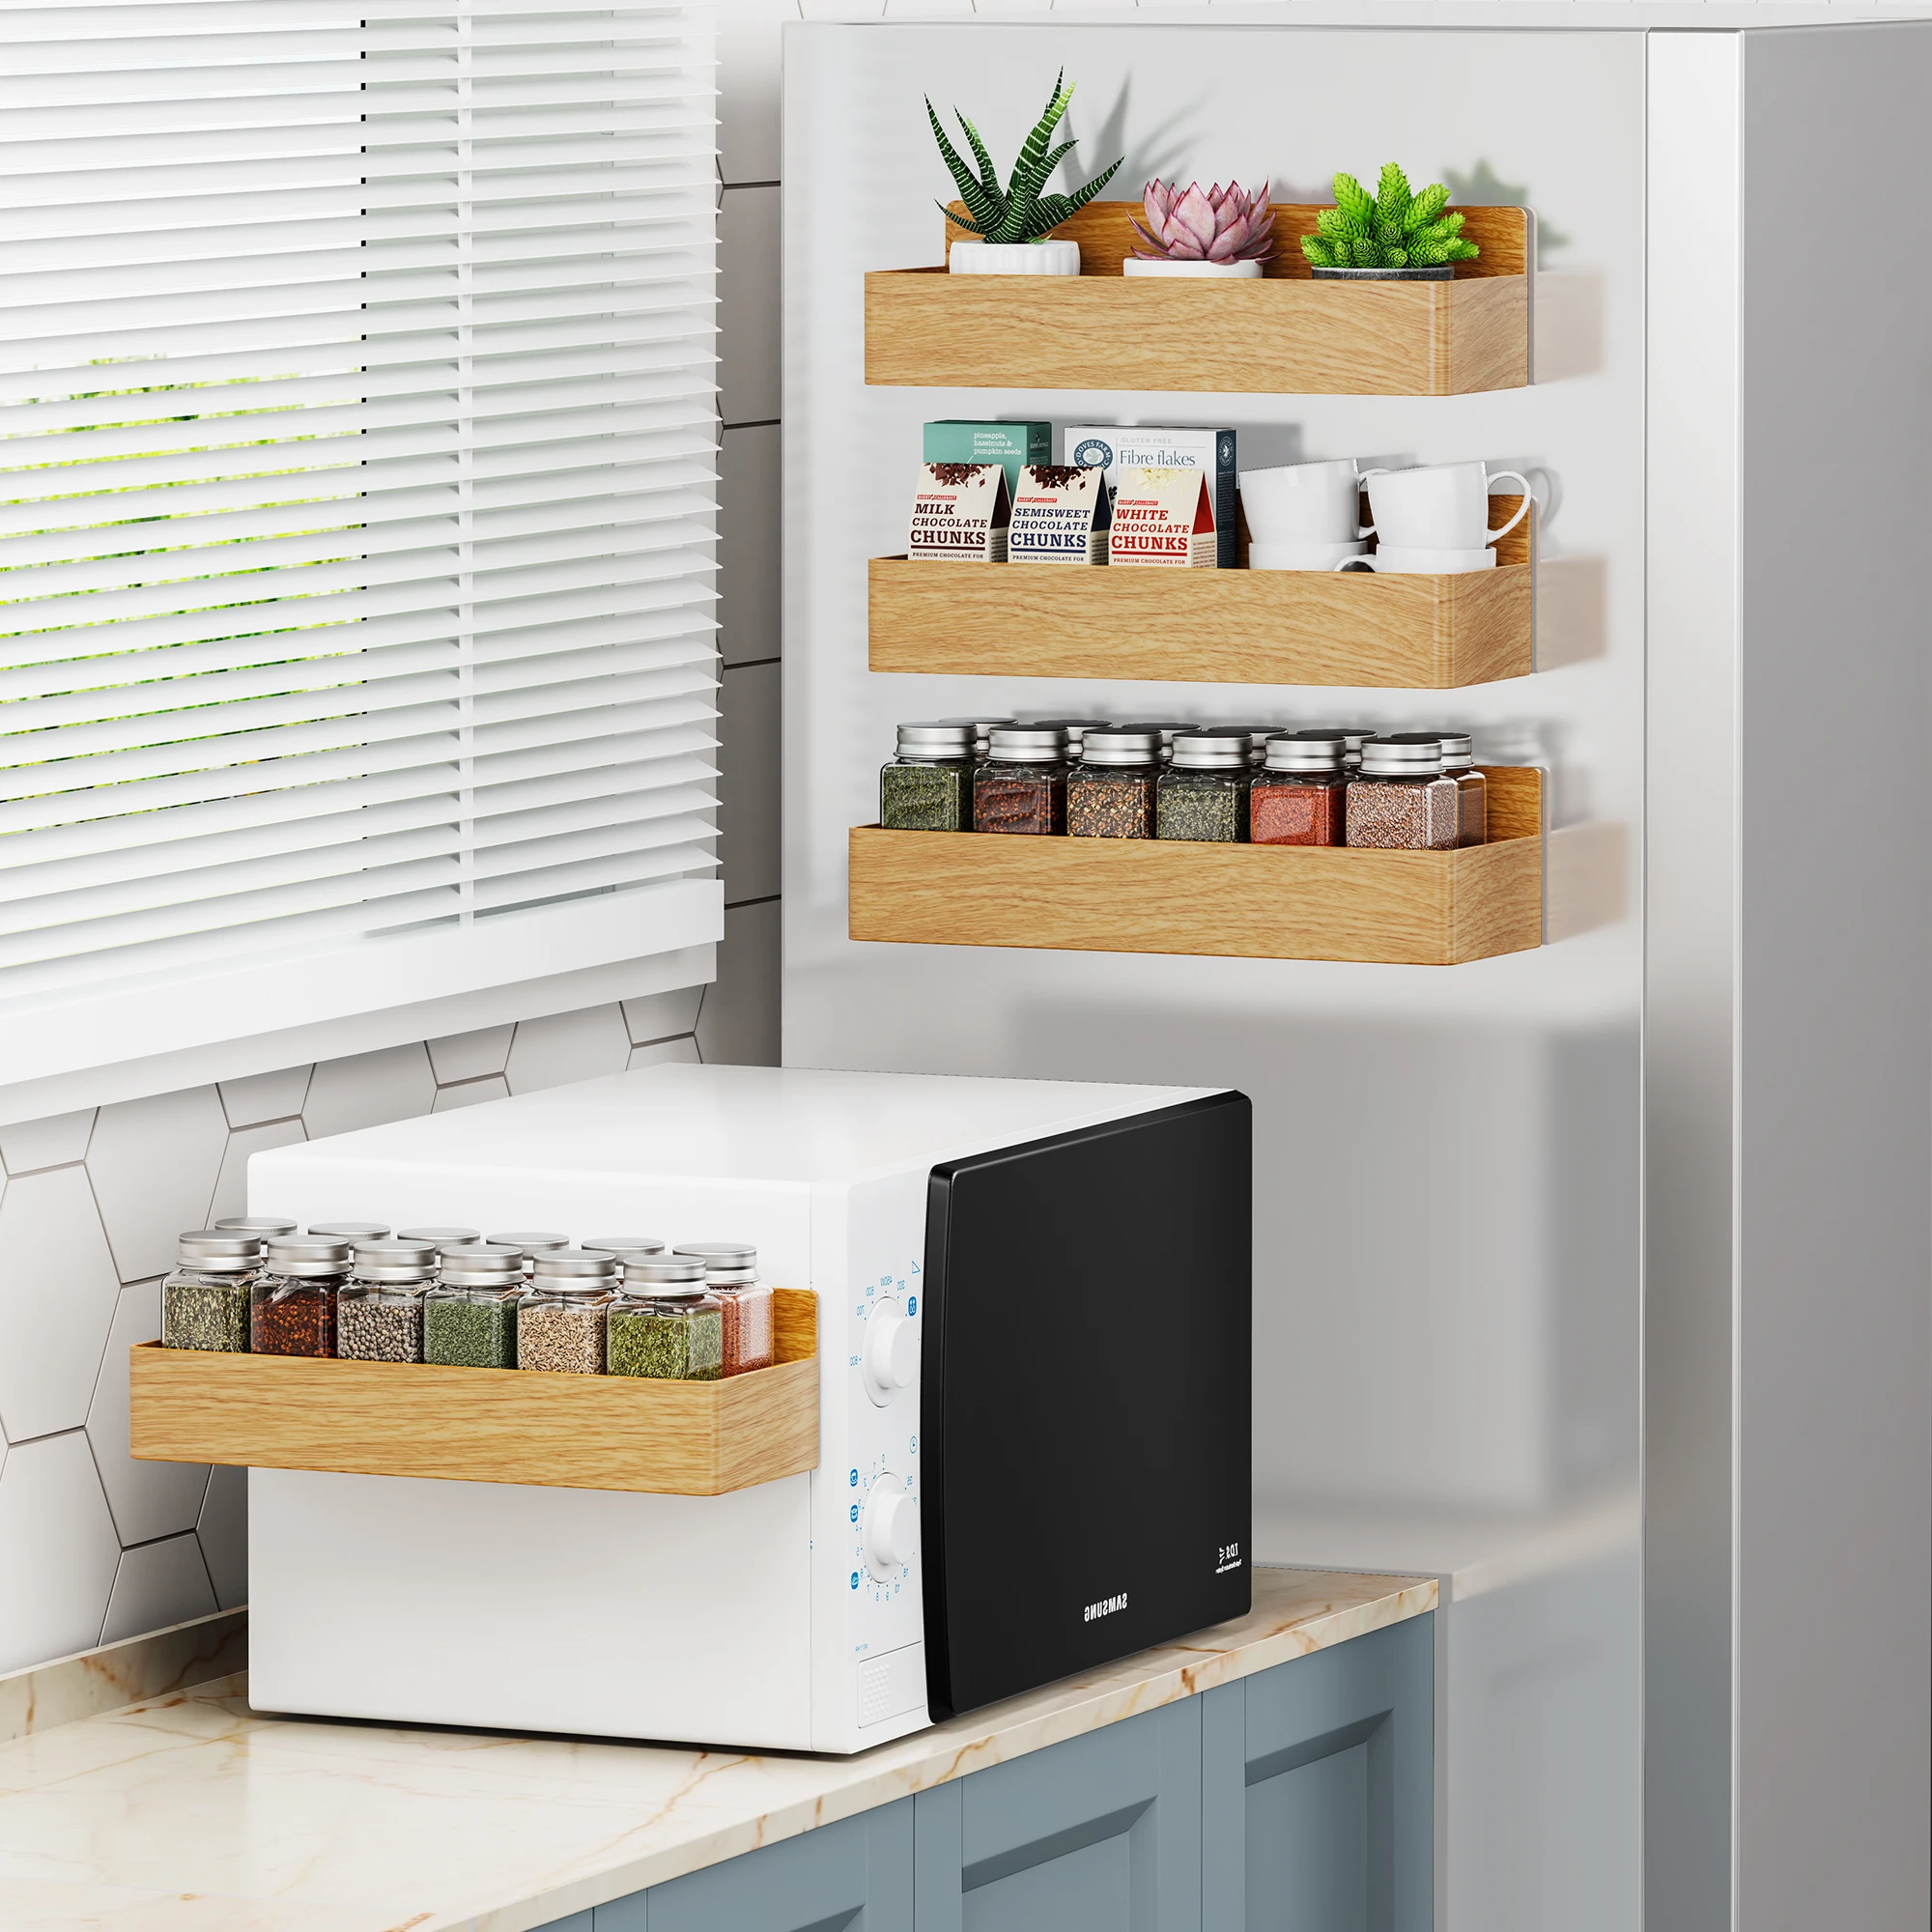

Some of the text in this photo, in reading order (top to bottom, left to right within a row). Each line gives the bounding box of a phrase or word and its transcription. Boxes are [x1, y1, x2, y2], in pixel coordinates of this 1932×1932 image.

[974, 432, 1007, 440] pineapple,
[1076, 440, 1111, 458] DOVES FARM
[1120, 450, 1195, 466] Fibre flakes
[914, 503, 955, 514] MILK
[1014, 508, 1090, 518] SEMISWEET
[1116, 509, 1168, 520] WHITE
[912, 518, 987, 528] CHOCOLATE
[1012, 521, 1088, 530] CHOCOLATE
[1113, 523, 1189, 533] CHOCOLATE
[910, 530, 985, 544] CHUNKS
[1010, 533, 1086, 547] CHUNKS
[1111, 536, 1187, 550] CHUNKS
